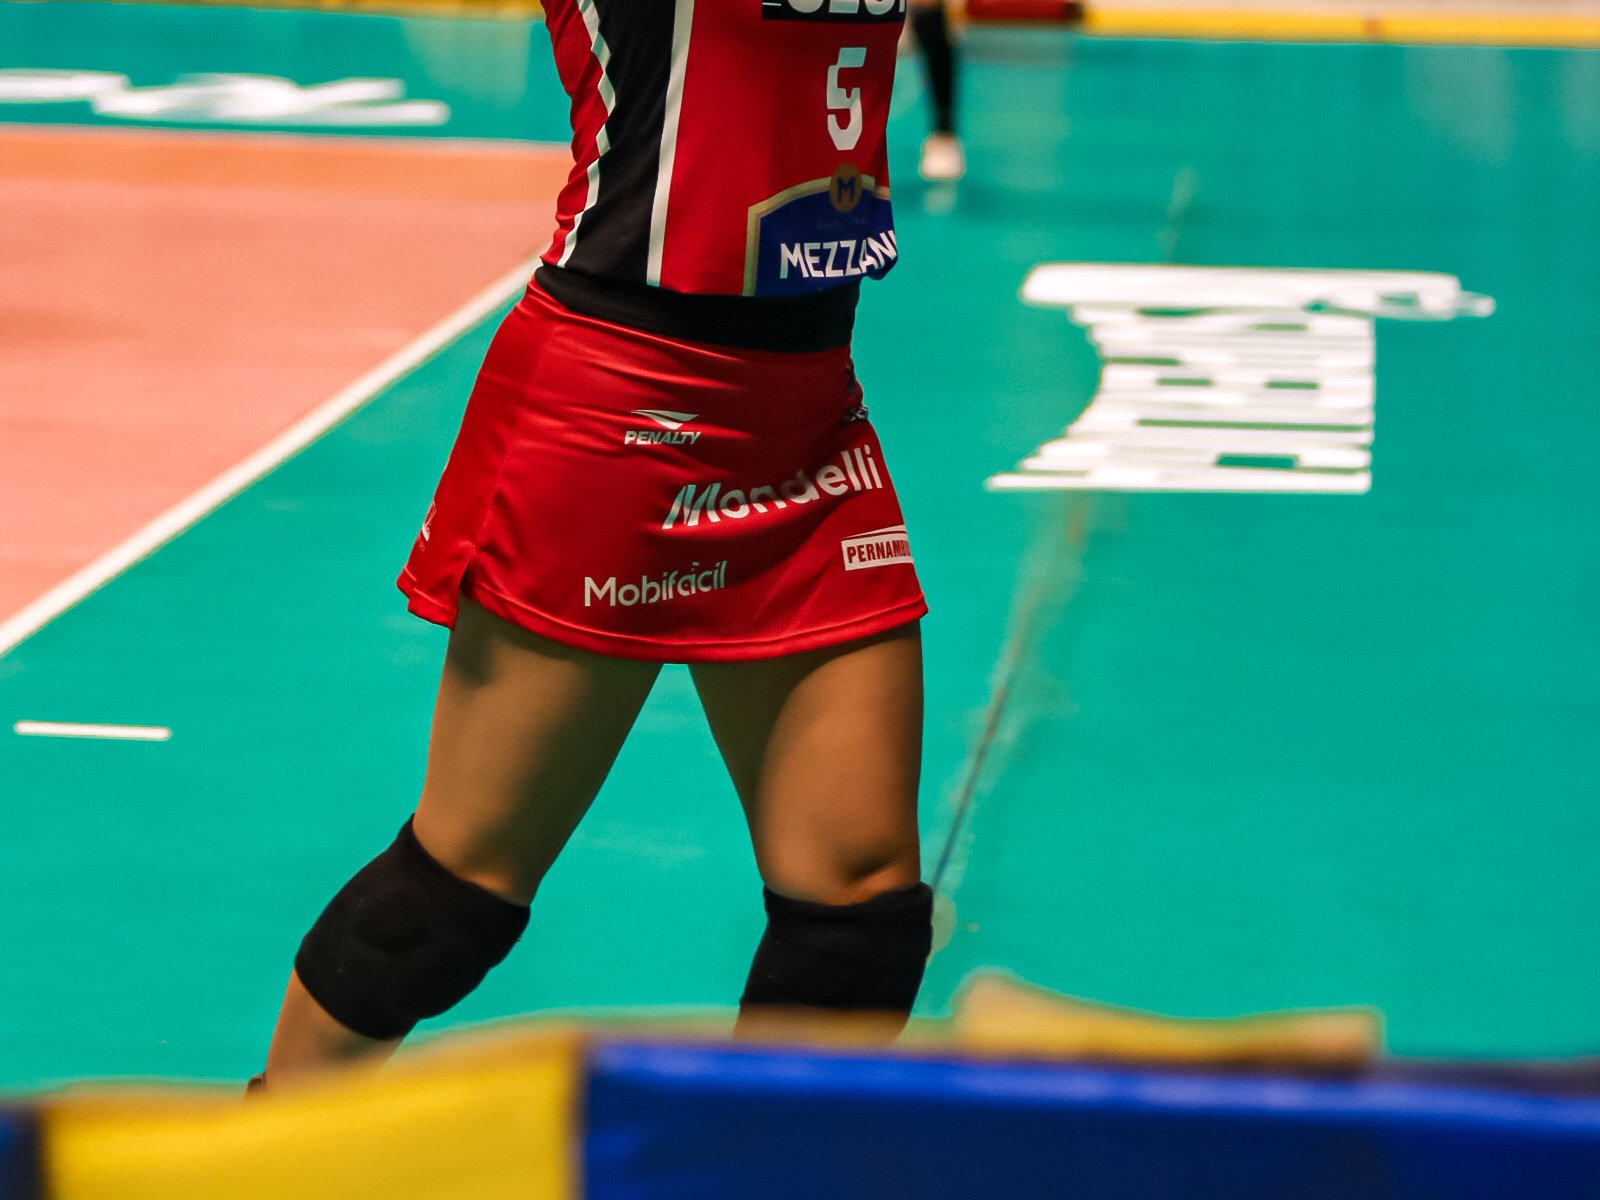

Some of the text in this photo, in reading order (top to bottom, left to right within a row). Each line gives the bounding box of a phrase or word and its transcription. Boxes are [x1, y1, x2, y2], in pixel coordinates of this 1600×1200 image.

[826, 47, 867, 151] 5
[837, 176, 857, 203] M
[624, 431, 701, 445] PENALTY
[662, 444, 883, 530] Mondelli
[584, 561, 727, 607] Mobifácil
